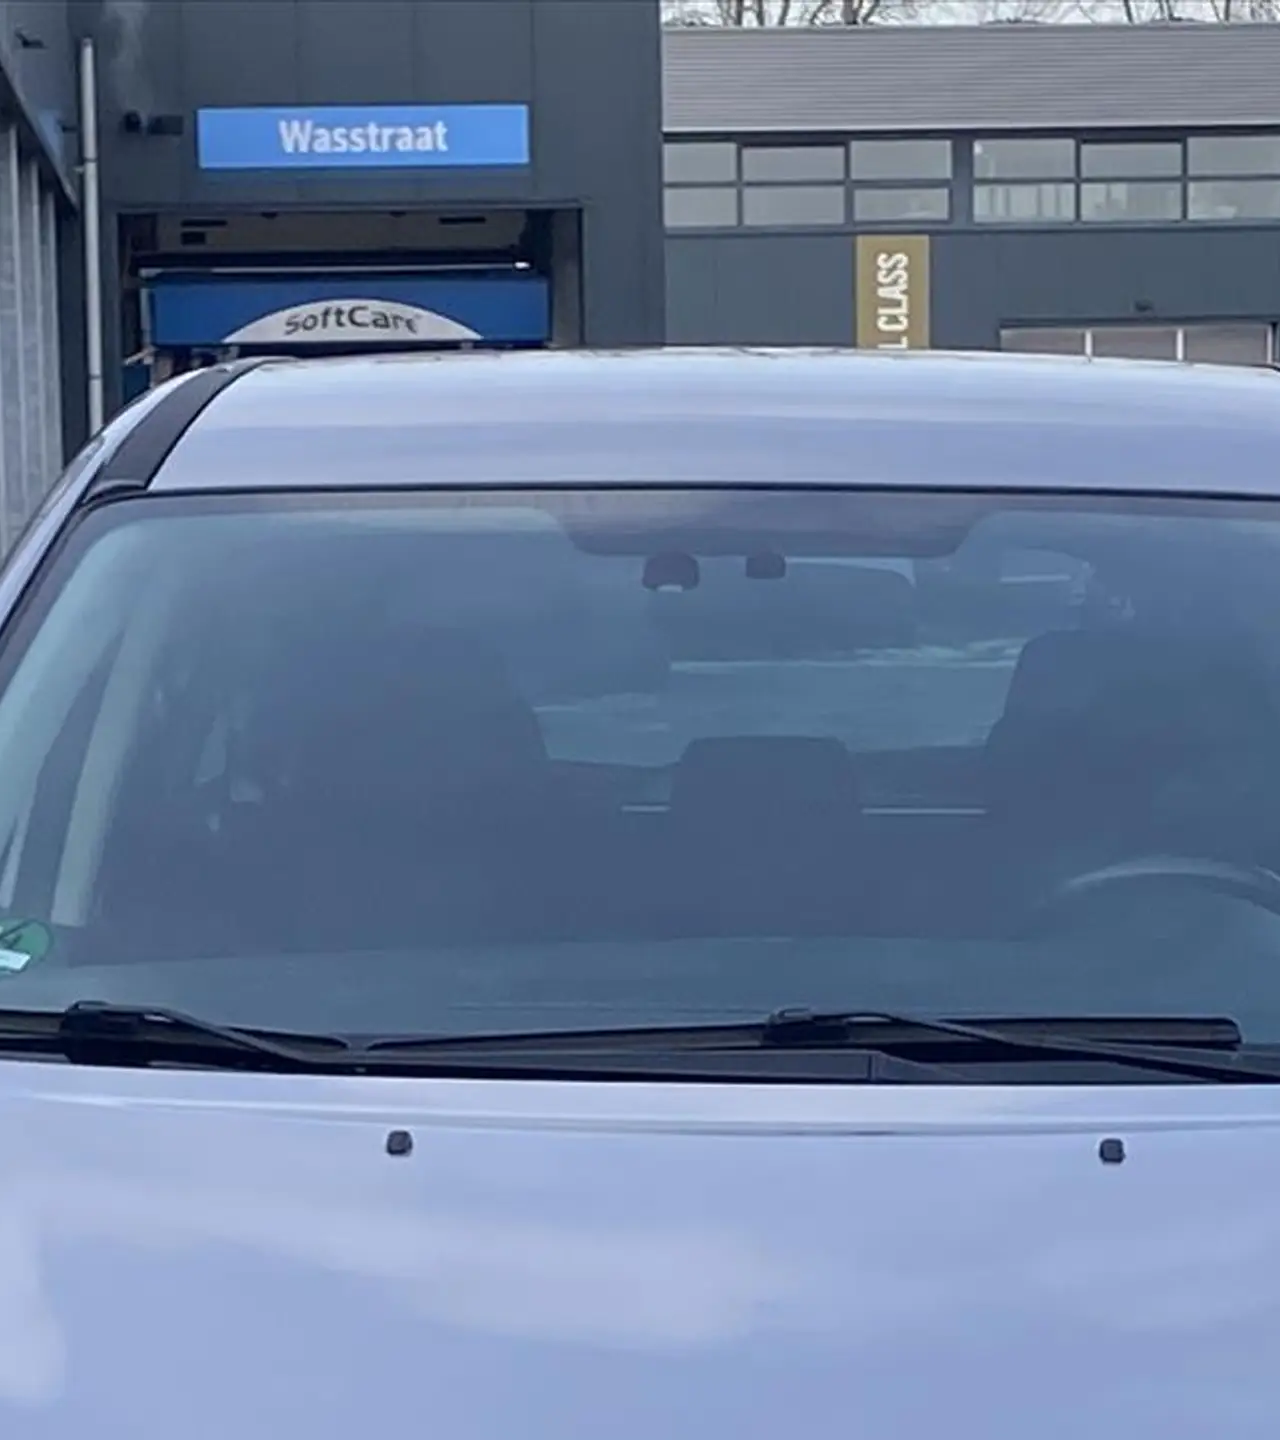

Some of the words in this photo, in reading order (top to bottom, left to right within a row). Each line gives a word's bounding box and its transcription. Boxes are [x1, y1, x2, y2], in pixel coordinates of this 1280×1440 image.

[278, 120, 448, 154] Wasstraat
[876, 252, 909, 332] CLASS
[284, 305, 420, 335] SoftCare
